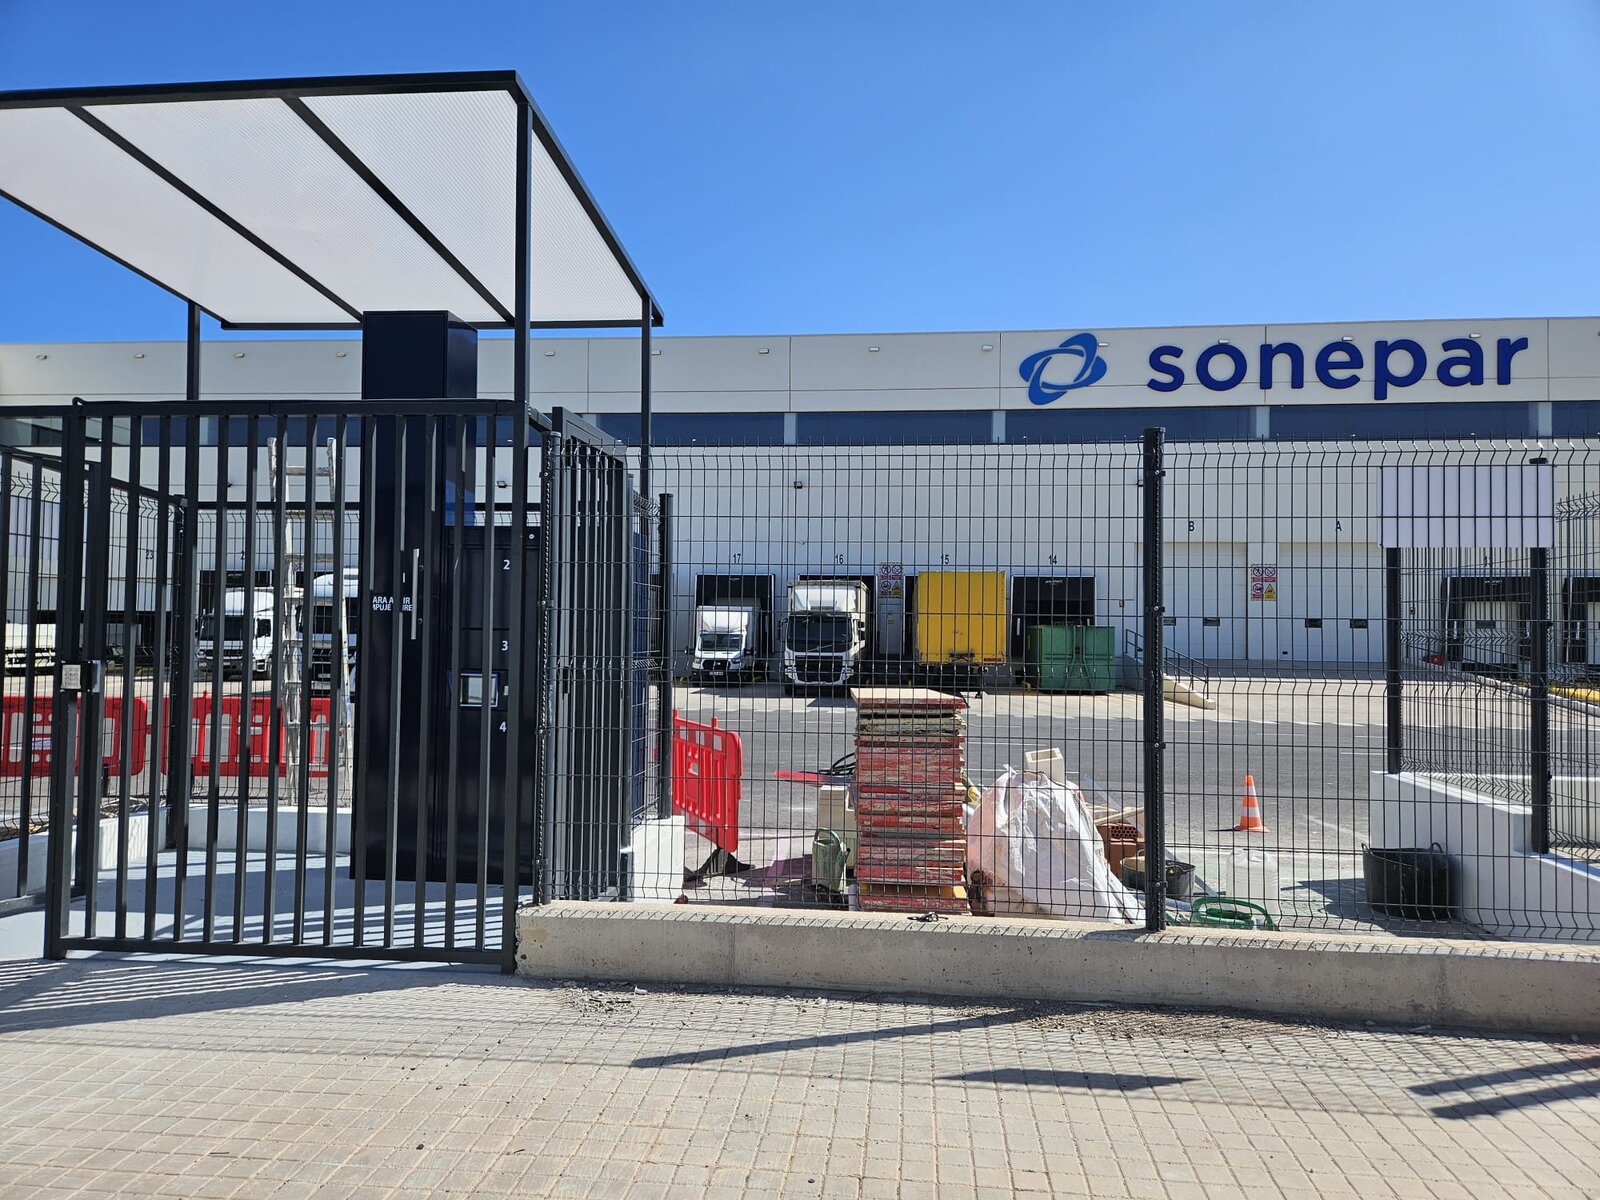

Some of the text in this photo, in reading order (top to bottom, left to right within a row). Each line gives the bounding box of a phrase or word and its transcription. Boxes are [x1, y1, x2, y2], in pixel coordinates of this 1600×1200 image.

[1146, 336, 1529, 400] sonepar
[1188, 521, 1195, 532] B
[1335, 521, 1342, 532] A
[732, 553, 742, 564] 17
[835, 554, 844, 565] 16
[940, 554, 950, 565] 15
[1048, 554, 1057, 565] 14
[502, 559, 511, 570] 2
[388, 596, 411, 605] AIR
[501, 640, 509, 651] 3
[499, 721, 507, 733] 4
